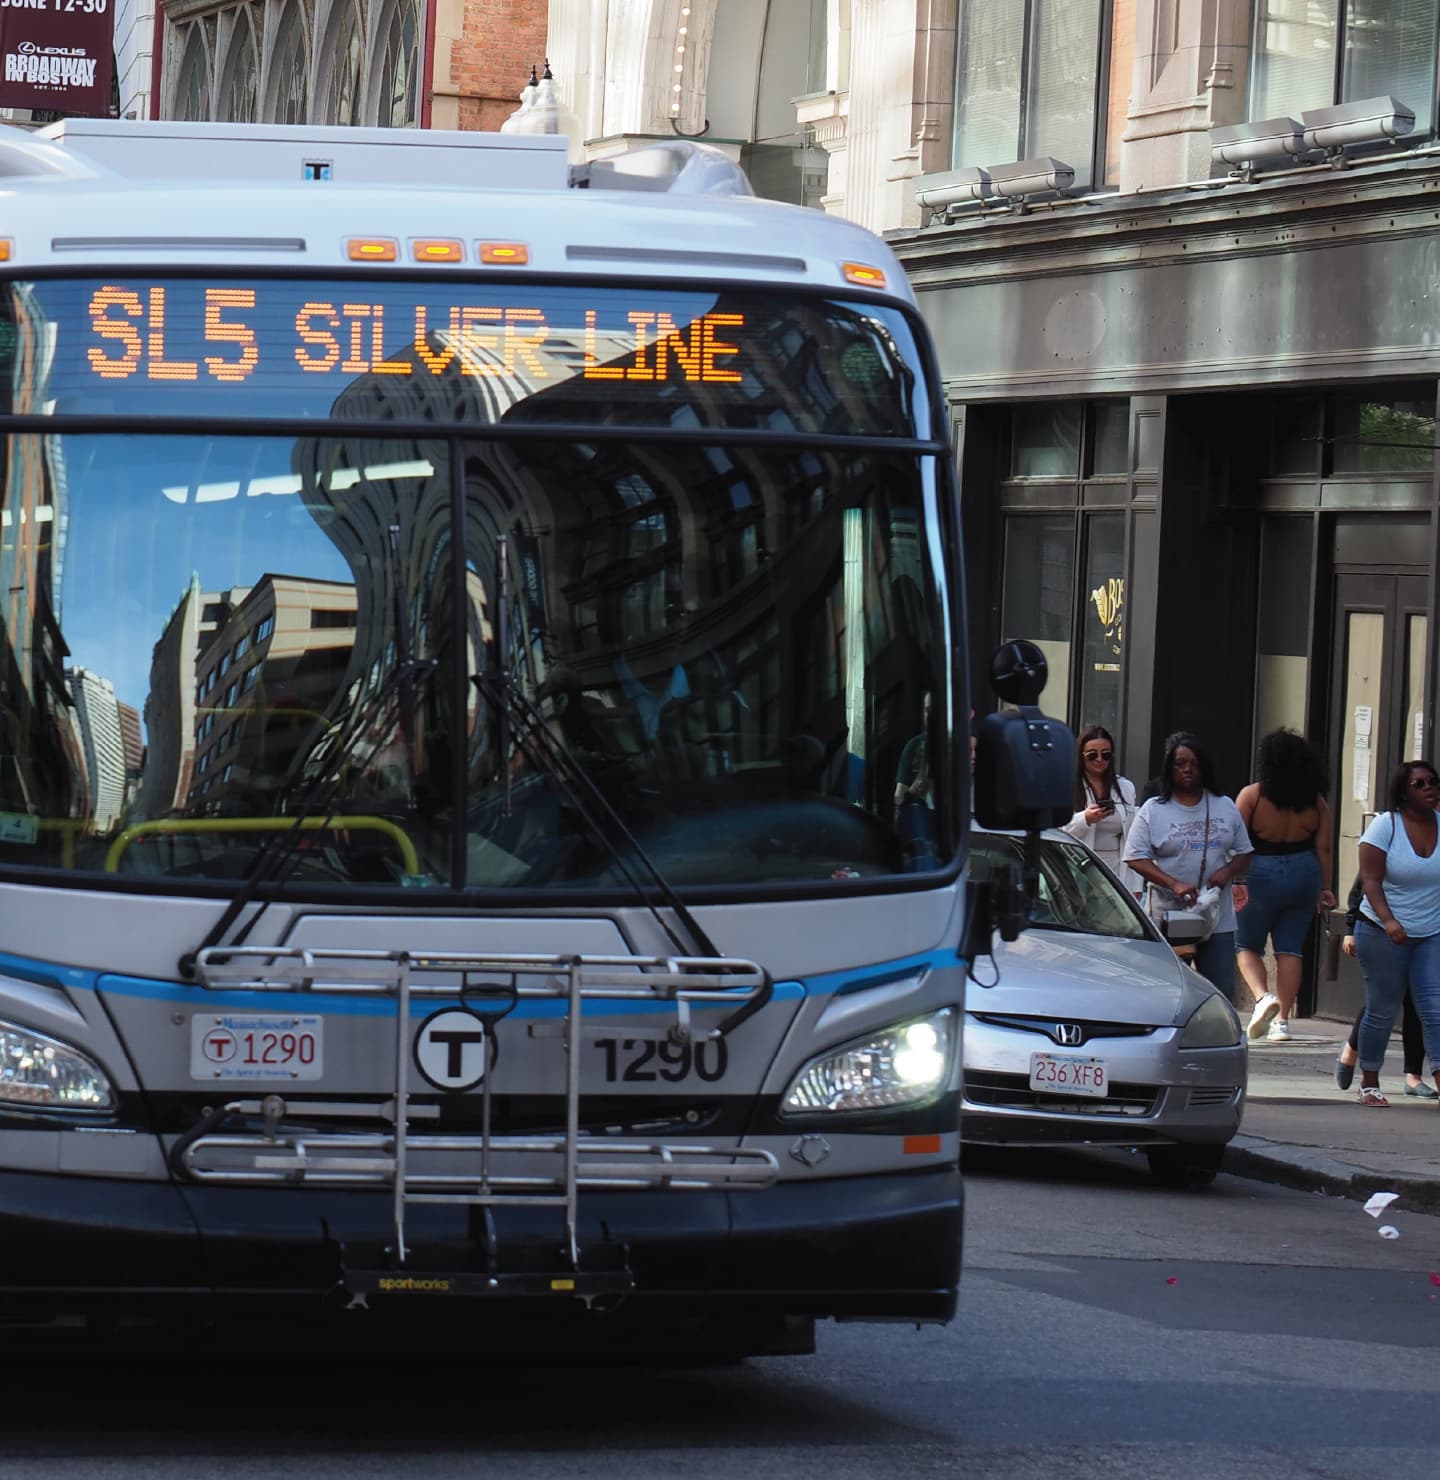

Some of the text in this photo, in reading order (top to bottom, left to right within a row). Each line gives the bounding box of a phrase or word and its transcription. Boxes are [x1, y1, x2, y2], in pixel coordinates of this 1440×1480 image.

[0, 0, 107, 13] JUNE 12-30
[36, 46, 86, 56] LEXUS
[5, 69, 95, 87] IN BOSTON
[6, 53, 97, 79] BROADWAY
[305, 163, 330, 180] T
[88, 285, 744, 382] SL5 SILVER LINE
[209, 1033, 316, 1064] T 1290
[429, 1031, 482, 1078] T
[594, 1037, 729, 1082] 1290
[1035, 1061, 1104, 1087] 236 XF8
[379, 1278, 450, 1291] sportworks
